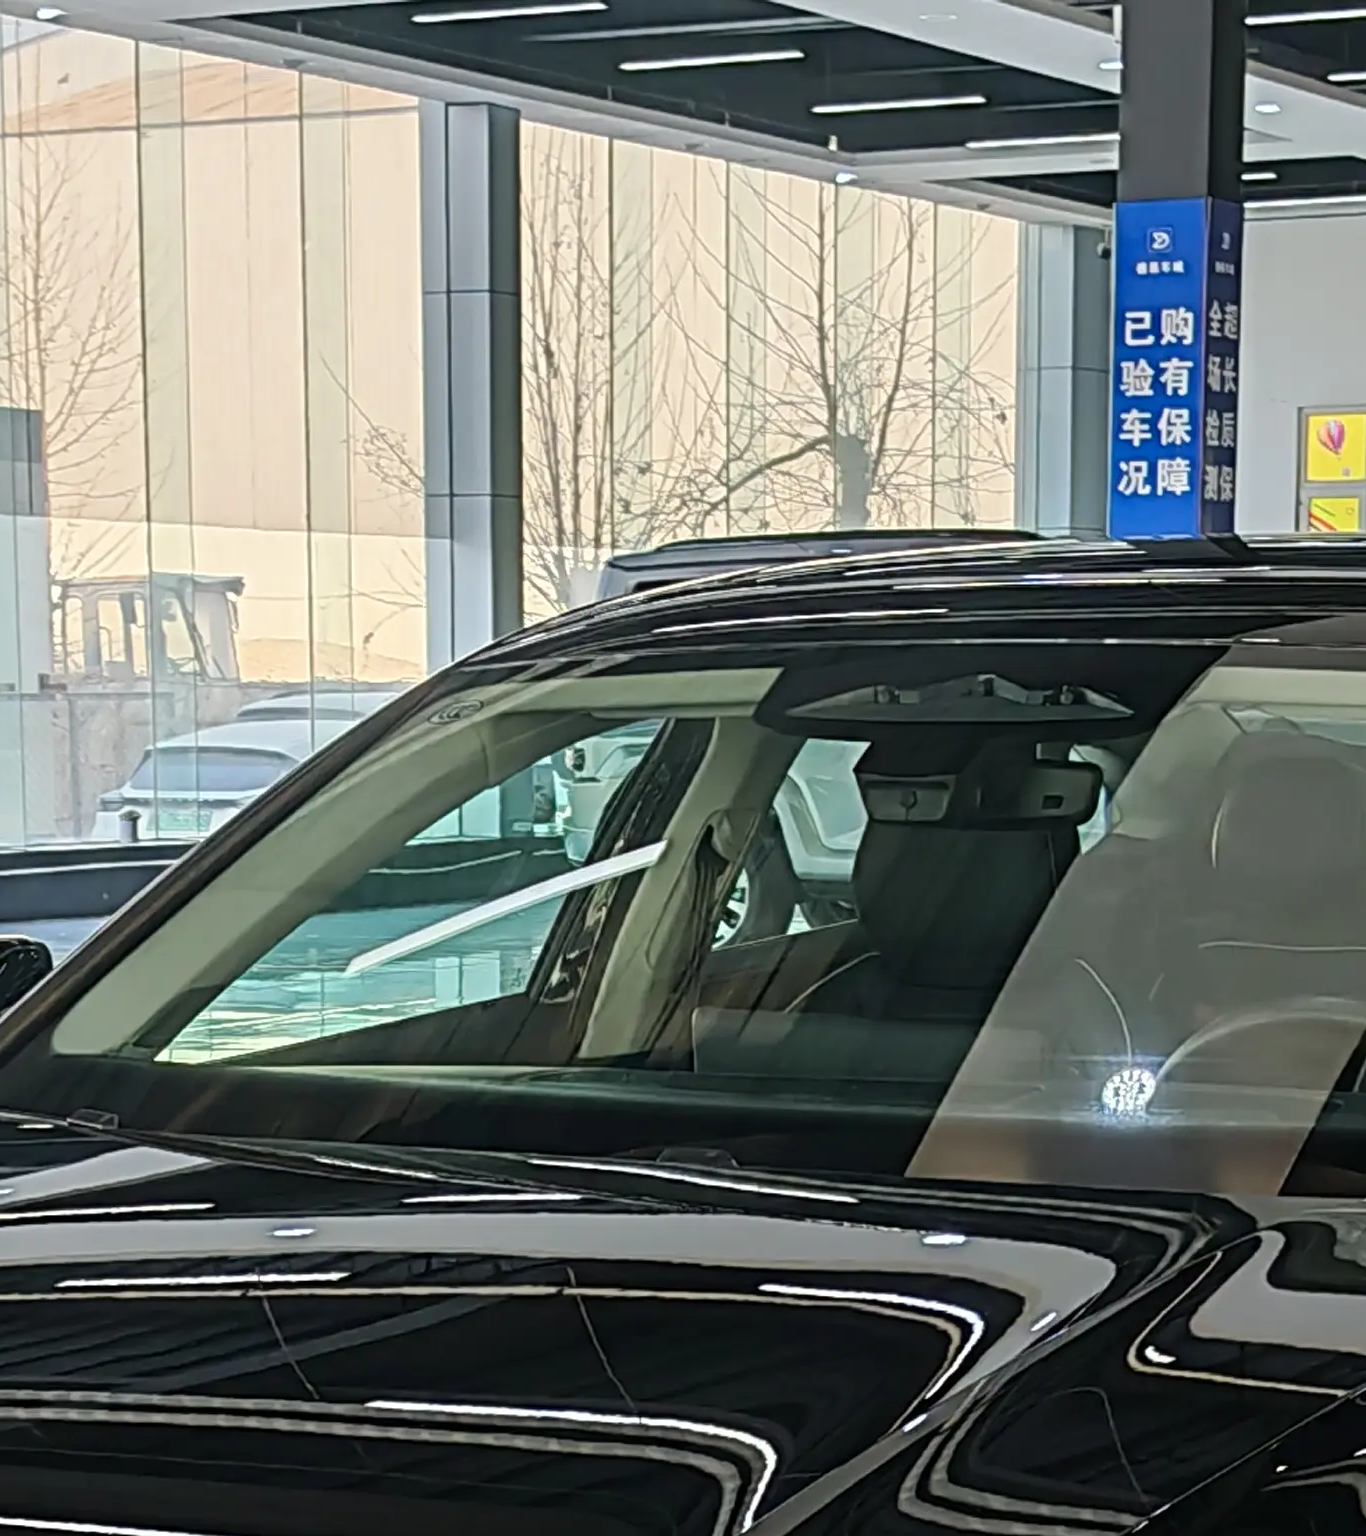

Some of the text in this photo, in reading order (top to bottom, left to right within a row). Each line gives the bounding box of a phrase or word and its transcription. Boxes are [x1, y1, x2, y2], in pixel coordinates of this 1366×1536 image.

[1117, 311, 1155, 497] 已验车况
[1156, 306, 1195, 497] 购有保障
